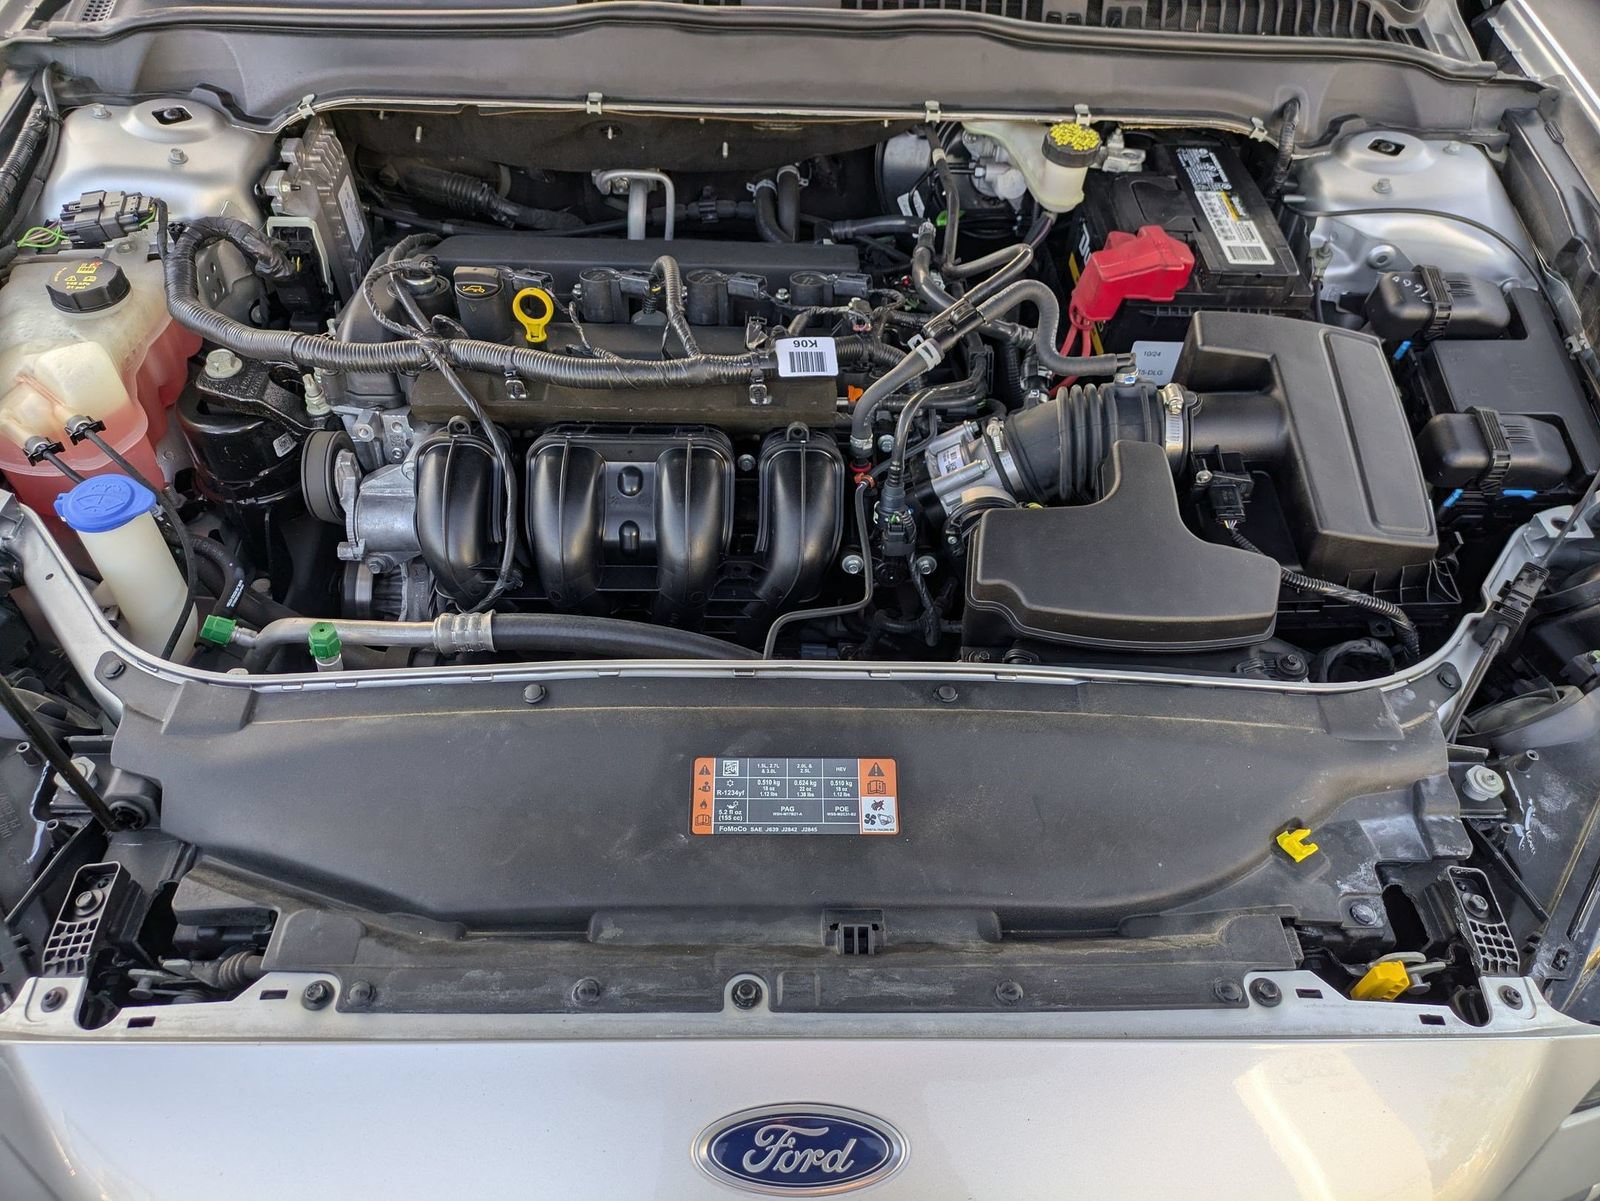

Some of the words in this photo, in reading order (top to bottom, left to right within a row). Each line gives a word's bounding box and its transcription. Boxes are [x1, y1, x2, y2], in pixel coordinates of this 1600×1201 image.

[793, 339, 818, 348] K06
[845, 780, 853, 788] kg
[742, 1124, 857, 1173] Ford
